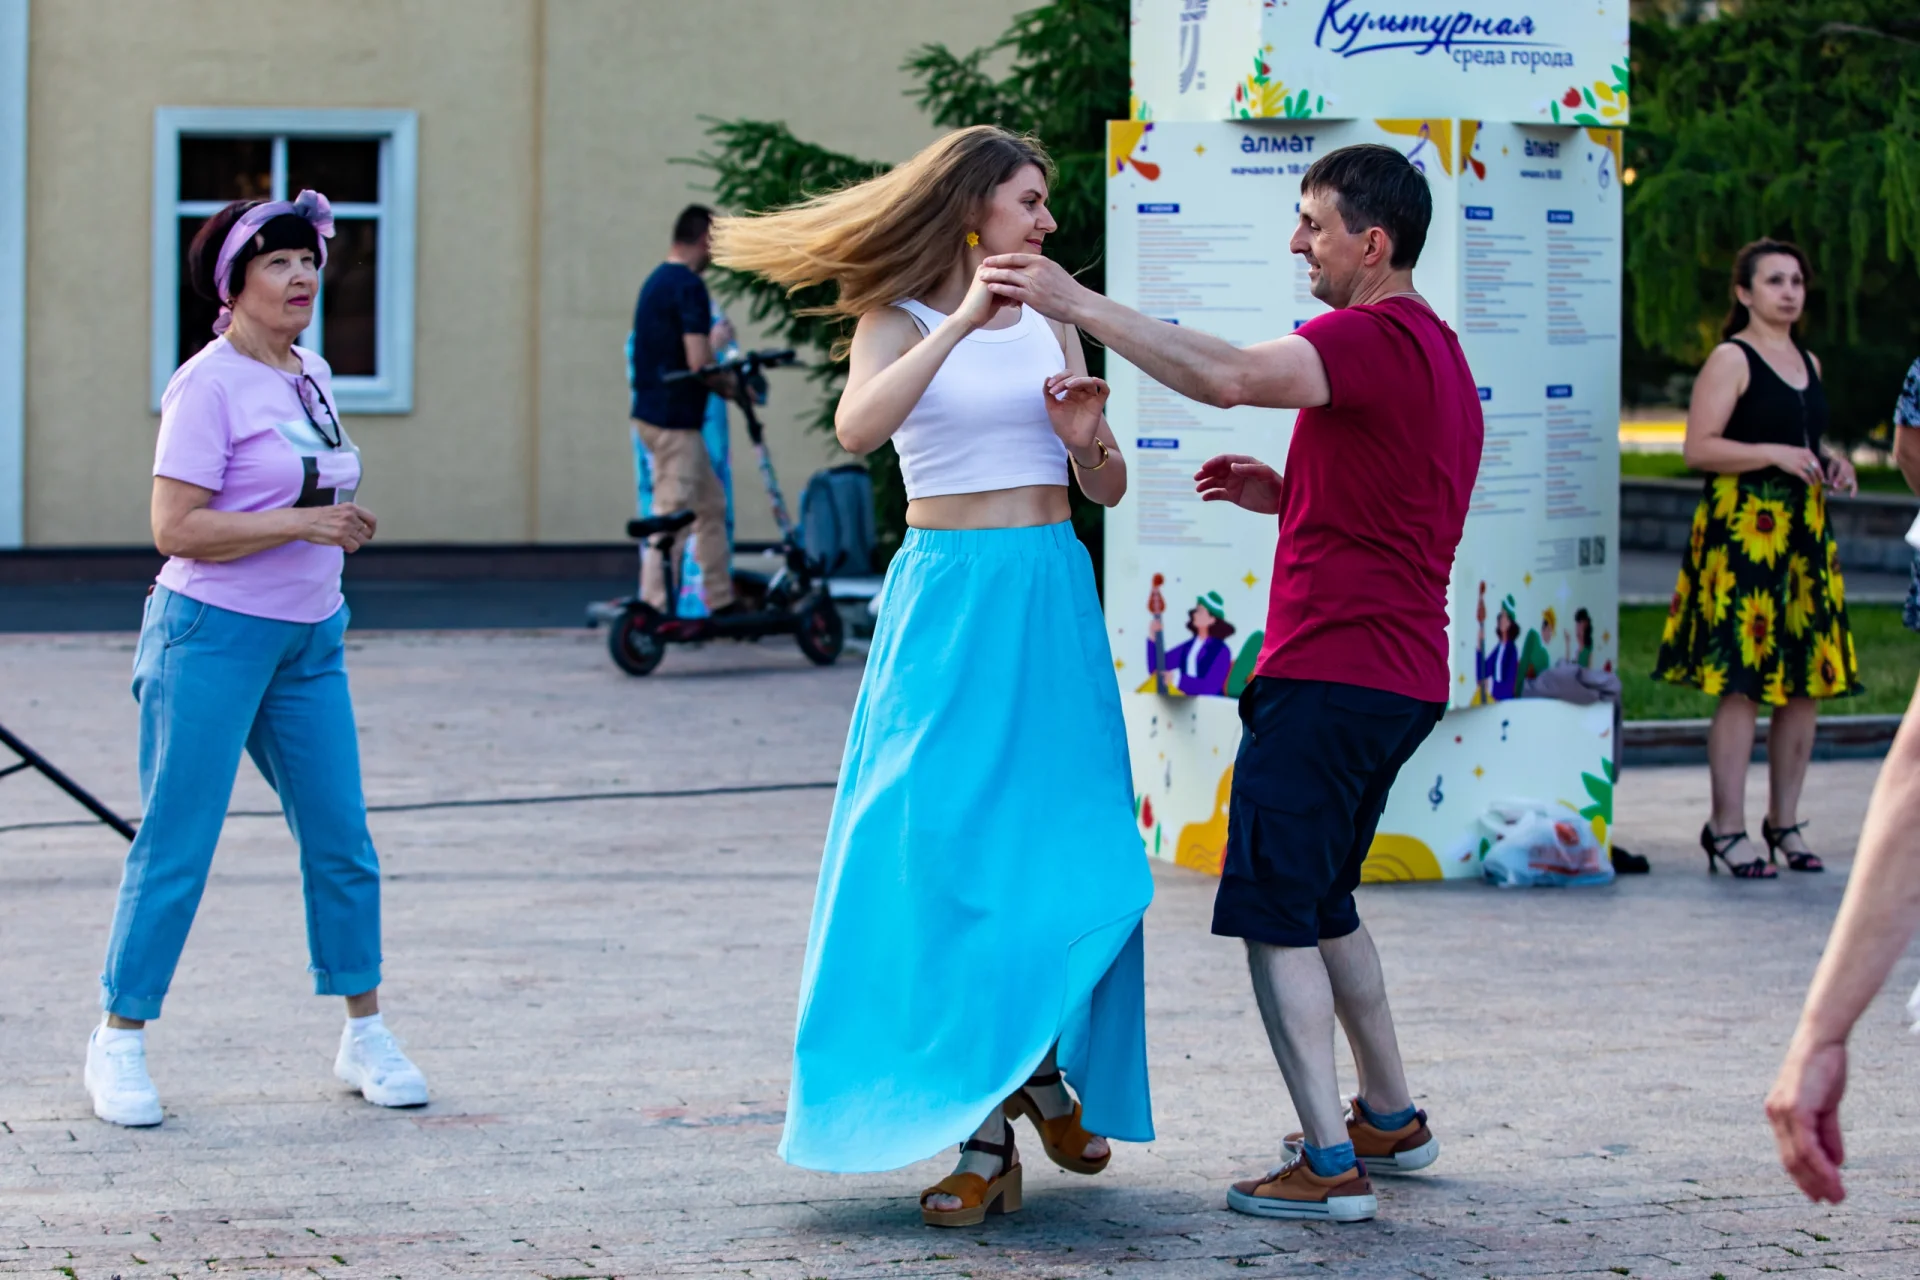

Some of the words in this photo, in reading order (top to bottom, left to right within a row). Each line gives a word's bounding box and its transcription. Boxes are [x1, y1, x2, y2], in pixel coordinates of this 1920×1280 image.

[1314, 0, 1535, 55] Культурная
[1452, 48, 1506, 71] среда
[1511, 50, 1575, 74] города
[1231, 165, 1275, 175] начало
